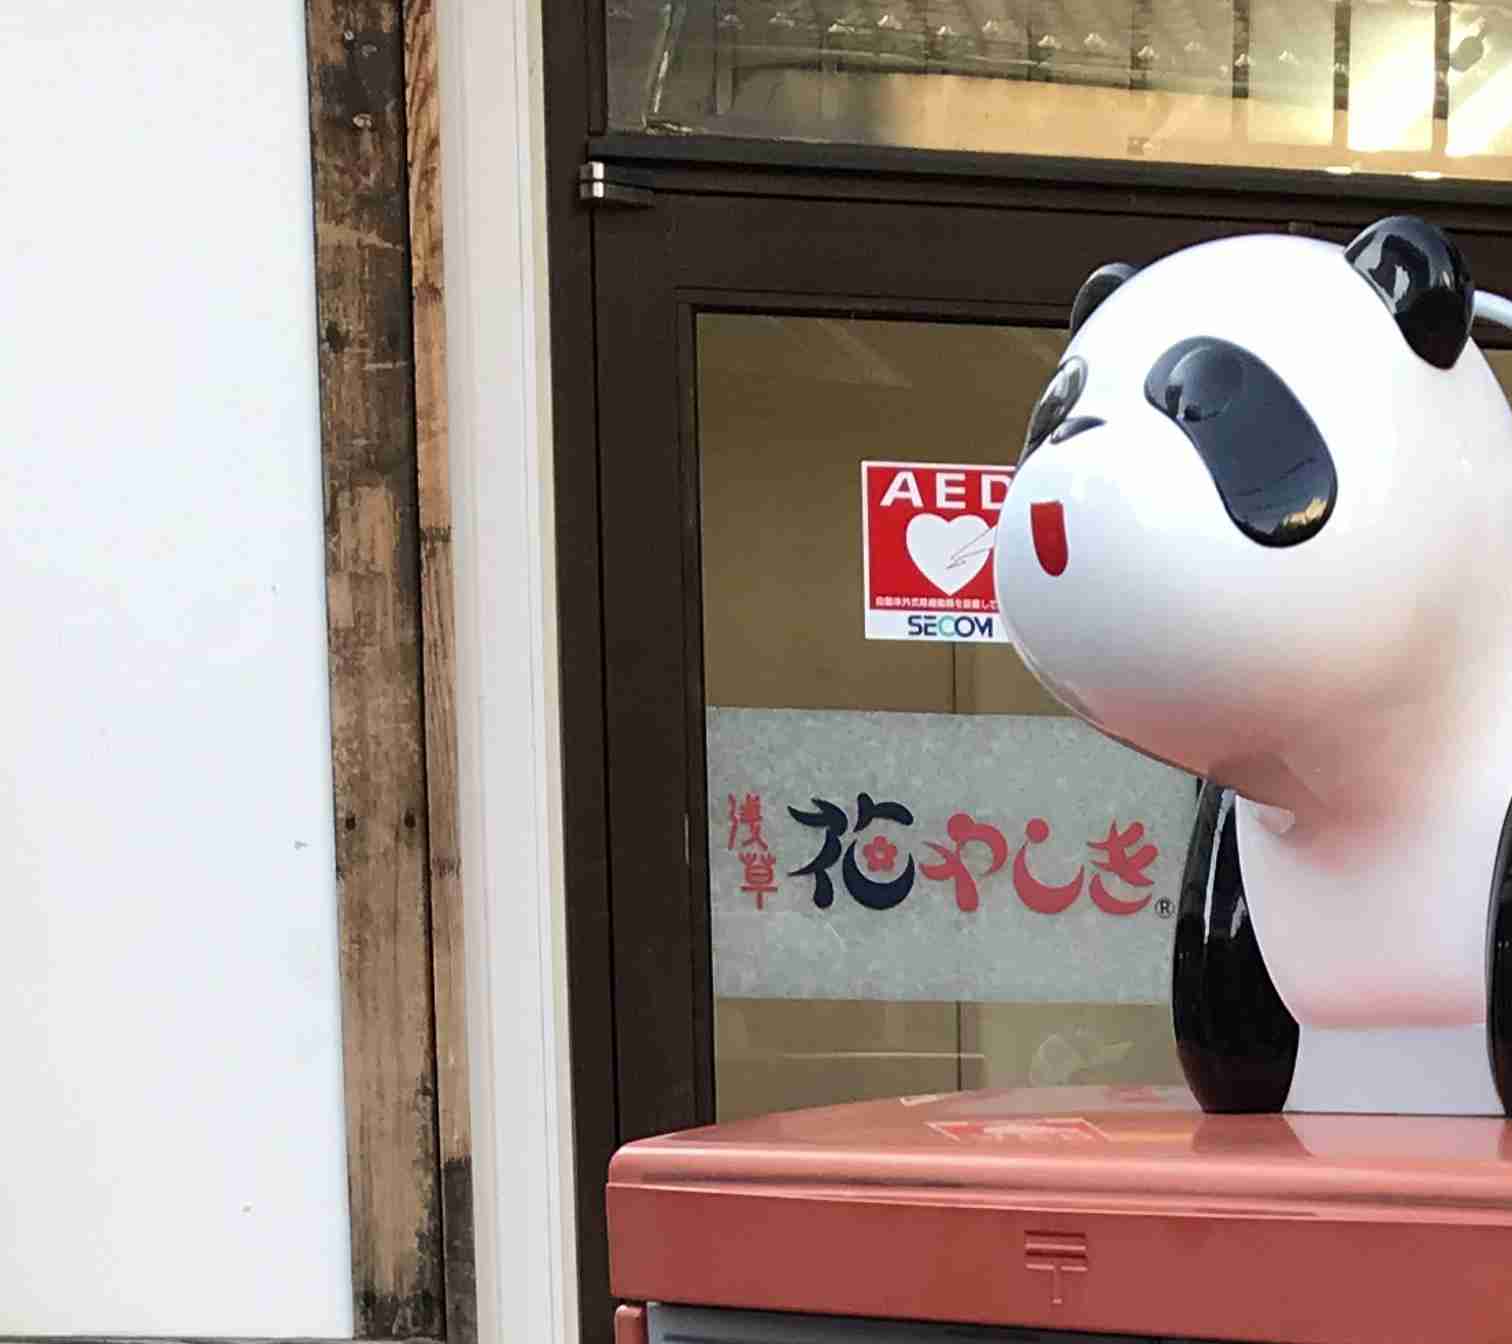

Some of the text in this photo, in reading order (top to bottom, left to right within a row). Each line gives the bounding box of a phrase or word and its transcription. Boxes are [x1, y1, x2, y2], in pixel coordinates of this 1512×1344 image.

[879, 470, 1013, 510] AED
[907, 615, 994, 638] SECOM
[727, 792, 779, 909] 浅草
[787, 791, 1159, 916] 花やしき
